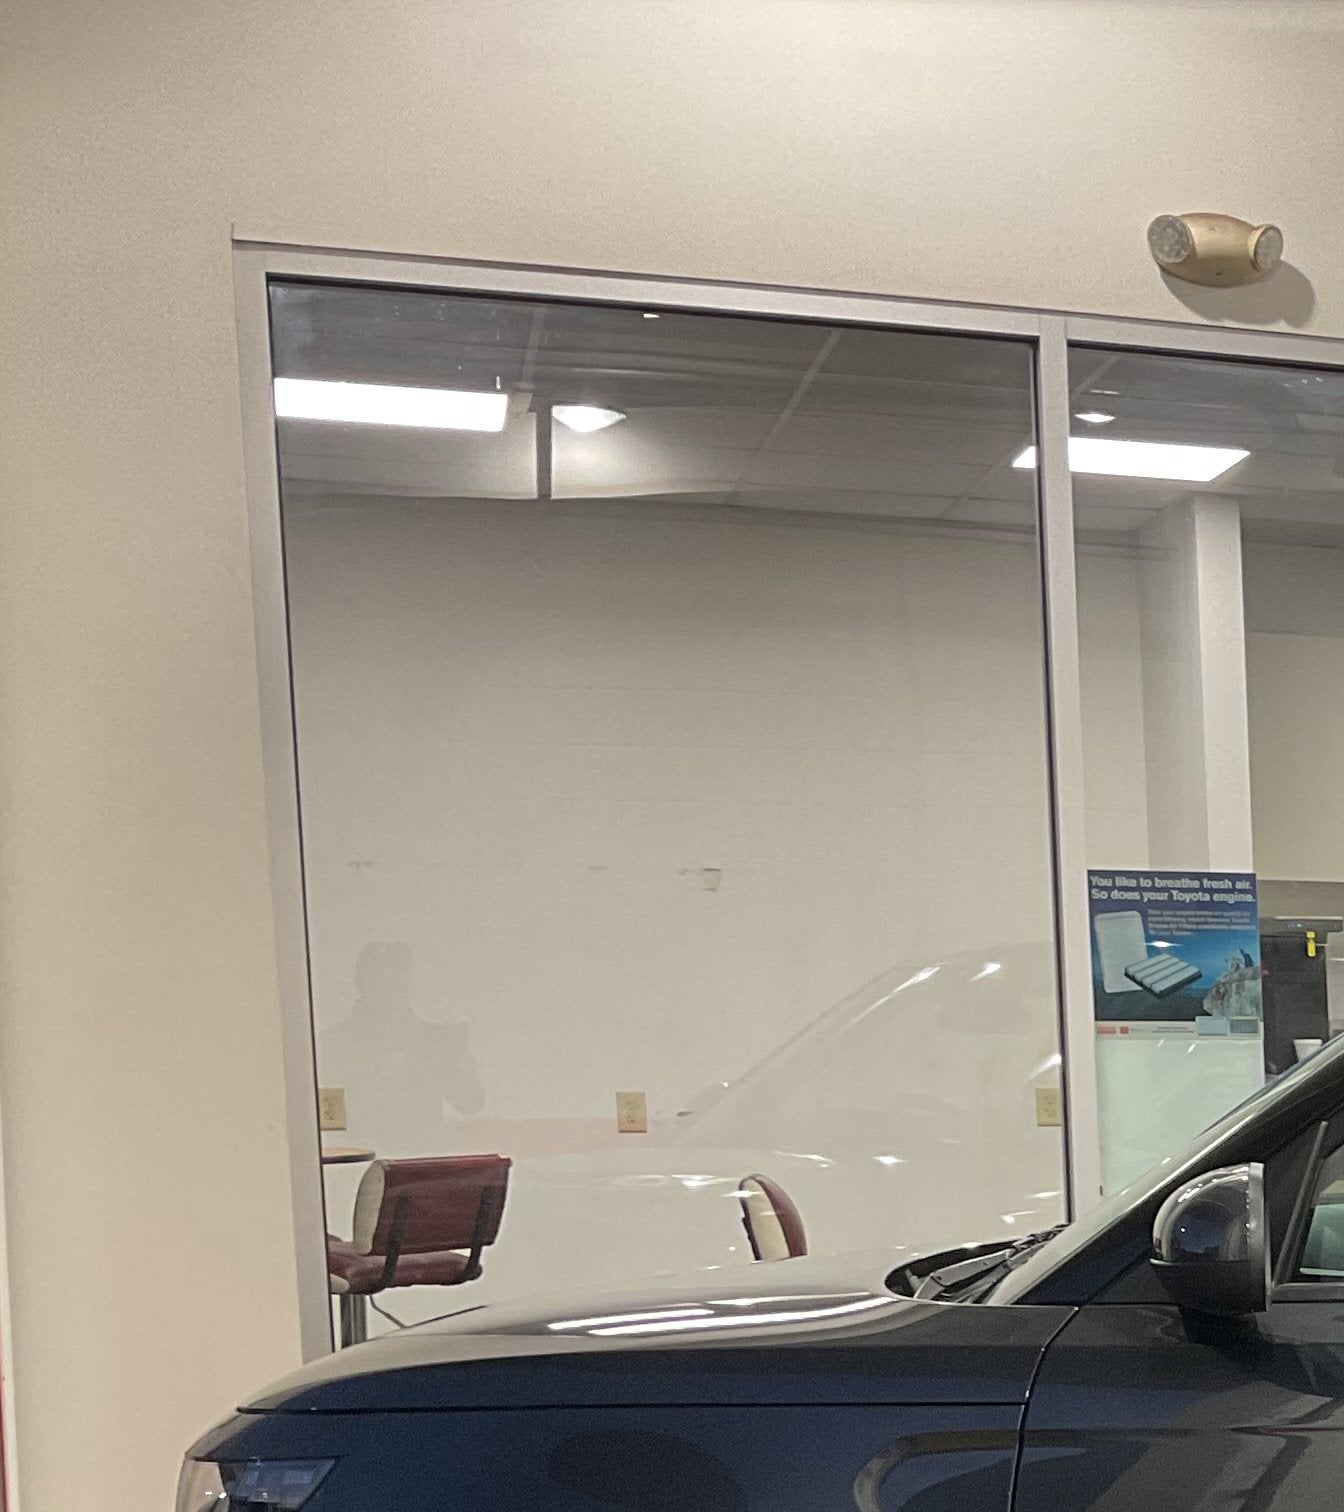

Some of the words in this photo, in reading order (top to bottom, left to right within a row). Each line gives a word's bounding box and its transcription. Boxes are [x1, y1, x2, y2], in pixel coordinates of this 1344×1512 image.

[1090, 876, 1112, 887] You
[1115, 876, 1137, 888] like
[1140, 877, 1152, 887] to
[1154, 877, 1200, 889] breathe
[1203, 878, 1232, 889] fresh
[1235, 879, 1253, 889] air.
[1090, 888, 1108, 899] So
[1111, 889, 1140, 900] does
[1143, 891, 1169, 902] your
[1170, 890, 1210, 903] Toyota
[1213, 892, 1256, 904] engine.
